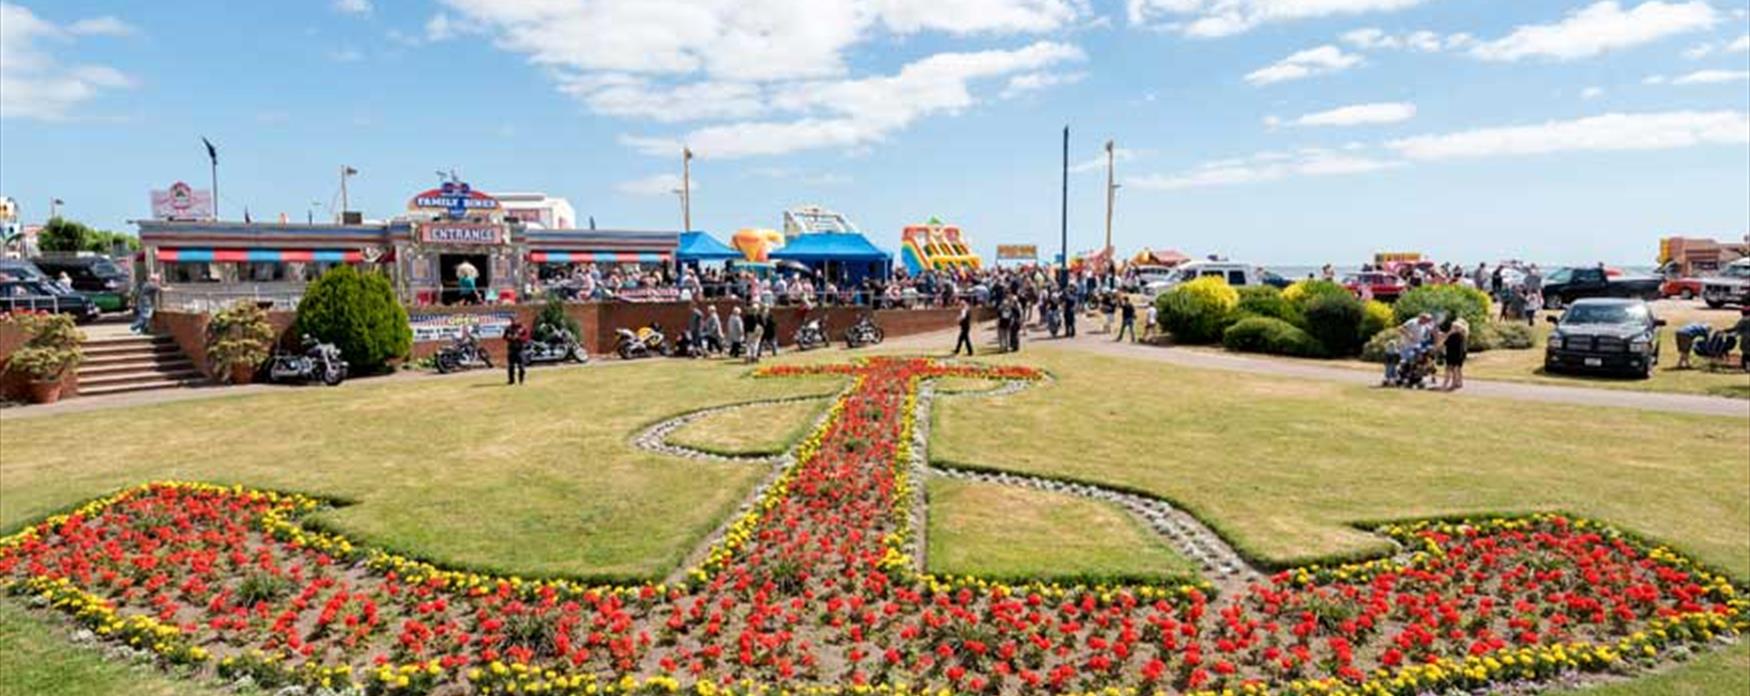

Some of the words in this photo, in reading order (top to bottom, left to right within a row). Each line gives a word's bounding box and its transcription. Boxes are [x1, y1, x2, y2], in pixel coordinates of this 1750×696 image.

[417, 197, 458, 207] FAMILY
[463, 199, 497, 208] DINER
[431, 227, 494, 241] ENTRANCE
[446, 315, 479, 326] OPEN
